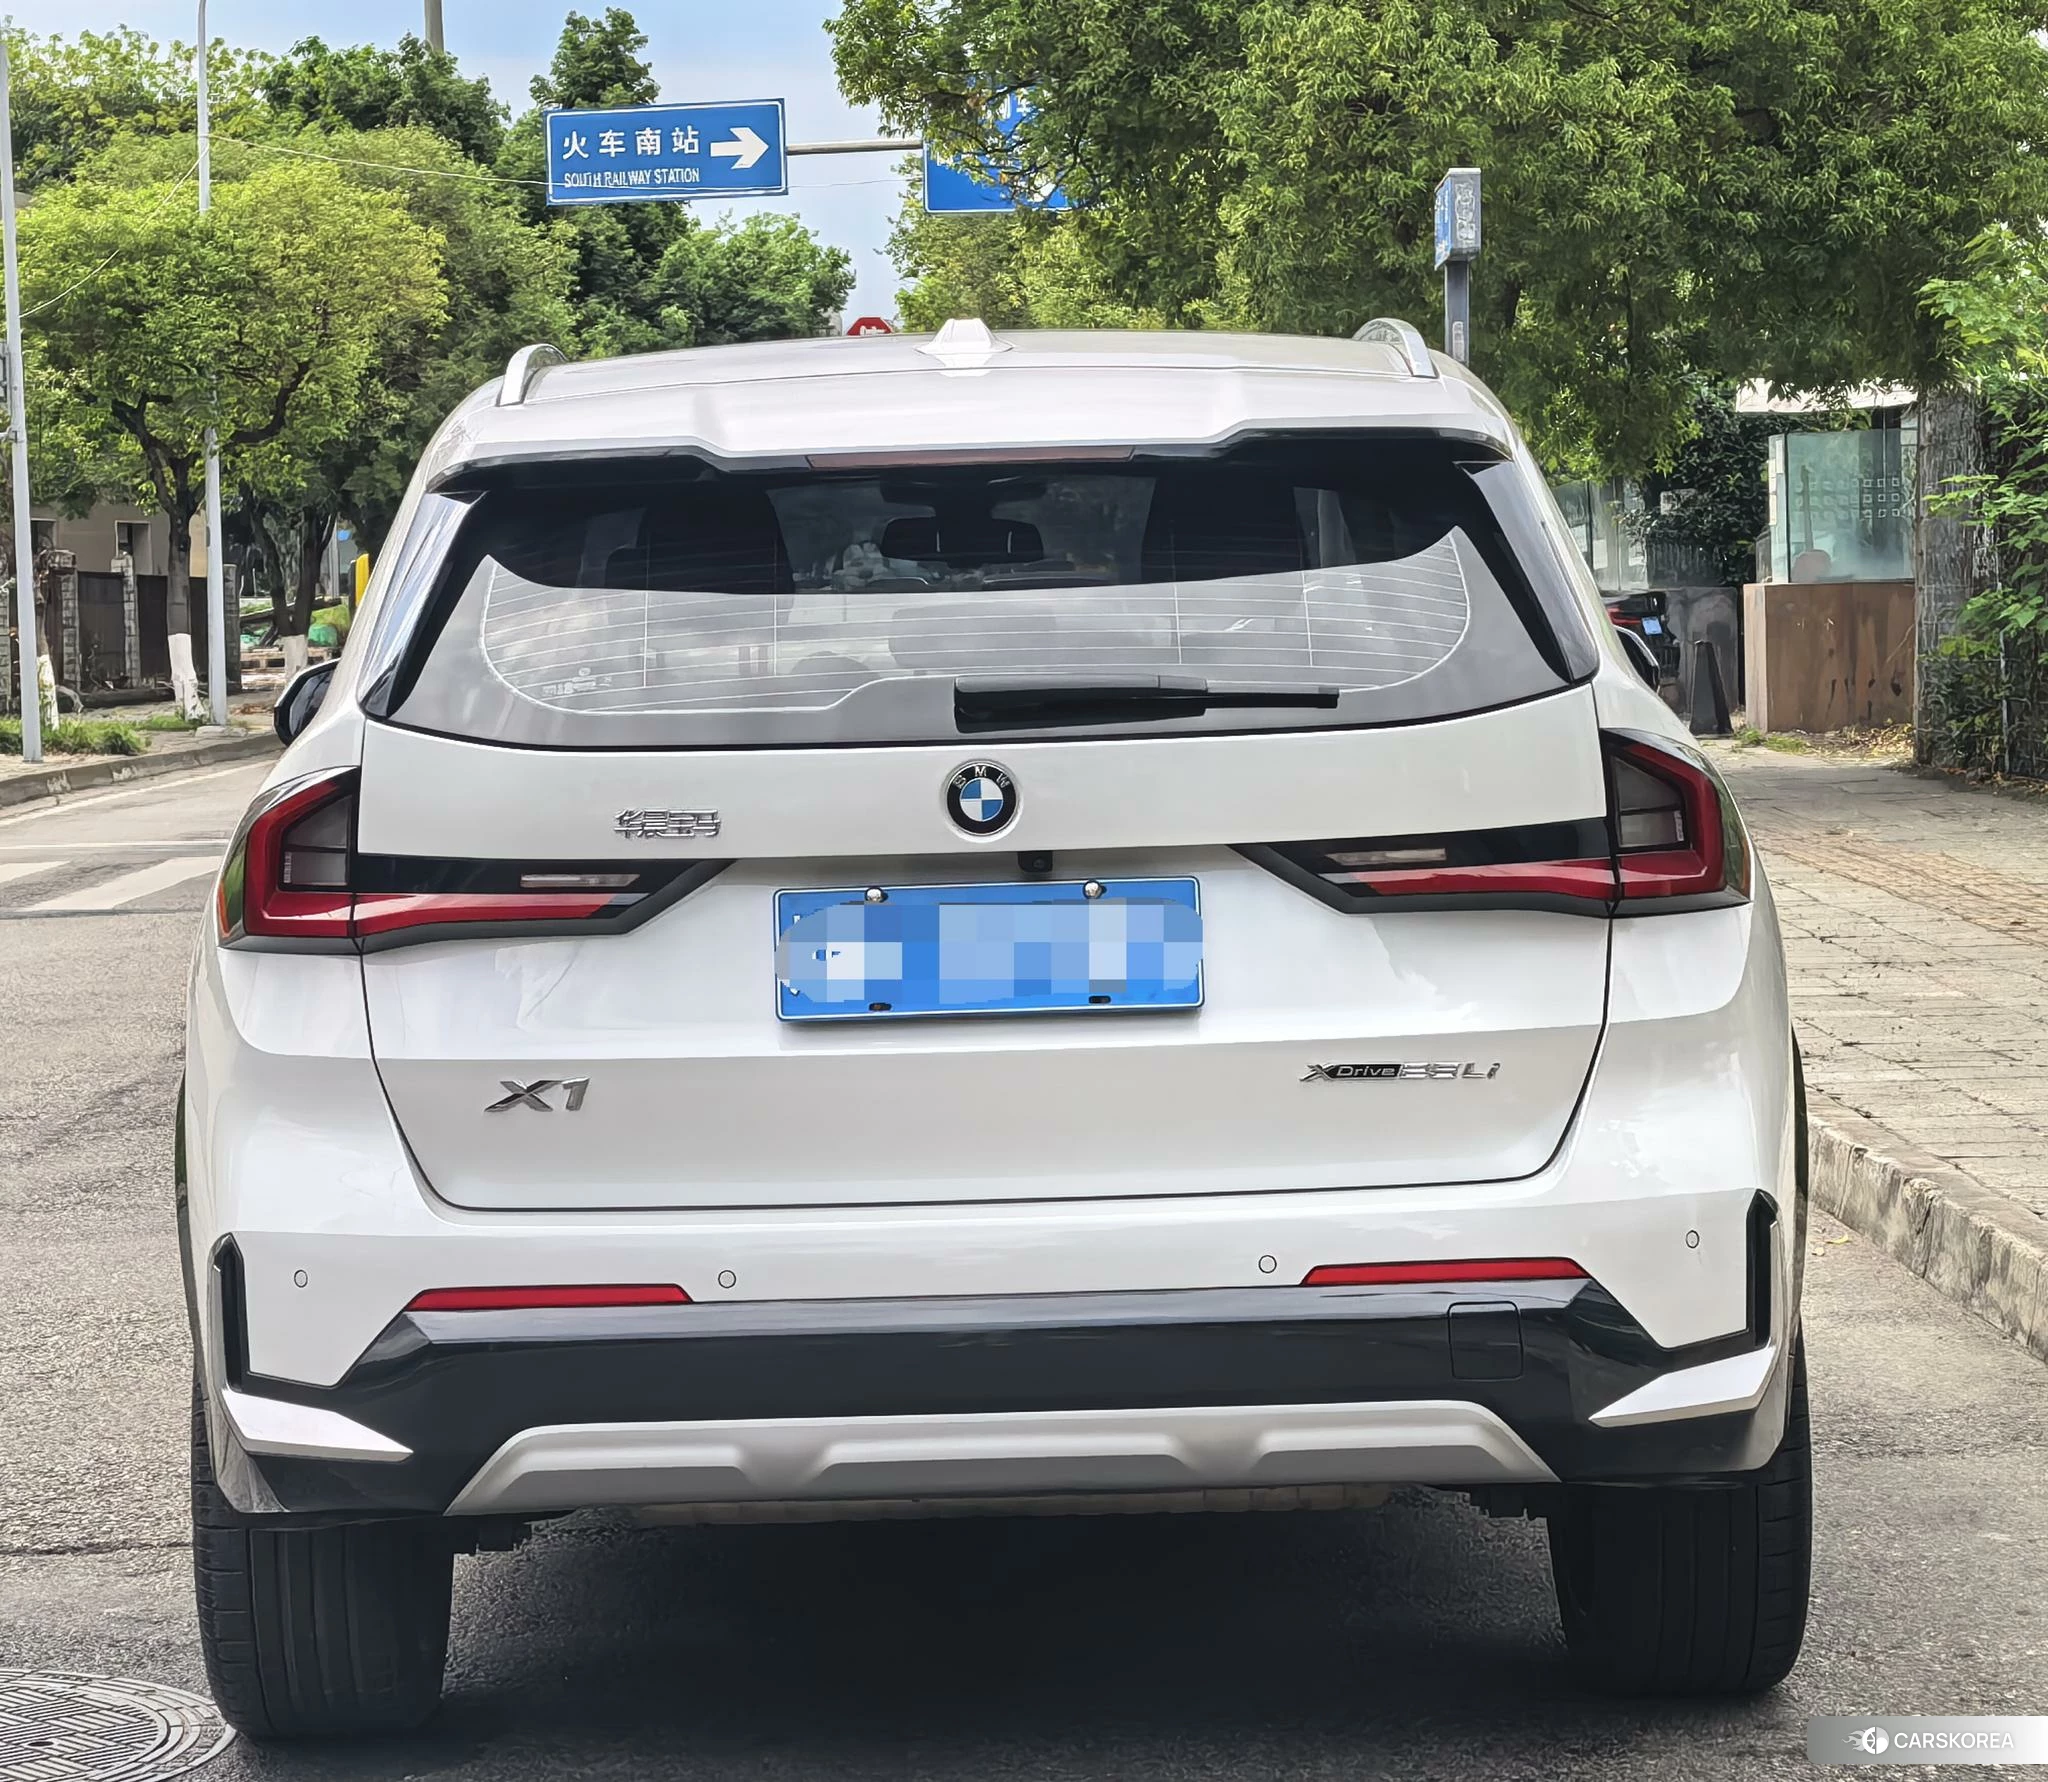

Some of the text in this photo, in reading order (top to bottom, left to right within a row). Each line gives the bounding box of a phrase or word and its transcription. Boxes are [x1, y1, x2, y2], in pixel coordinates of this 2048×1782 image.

[562, 125, 700, 160] 火车南站
[564, 167, 700, 188] SOUTH RAILWAY STATION
[953, 765, 1010, 790] BMW
[613, 808, 721, 839] 华晨宝马
[483, 1077, 590, 1112] X1
